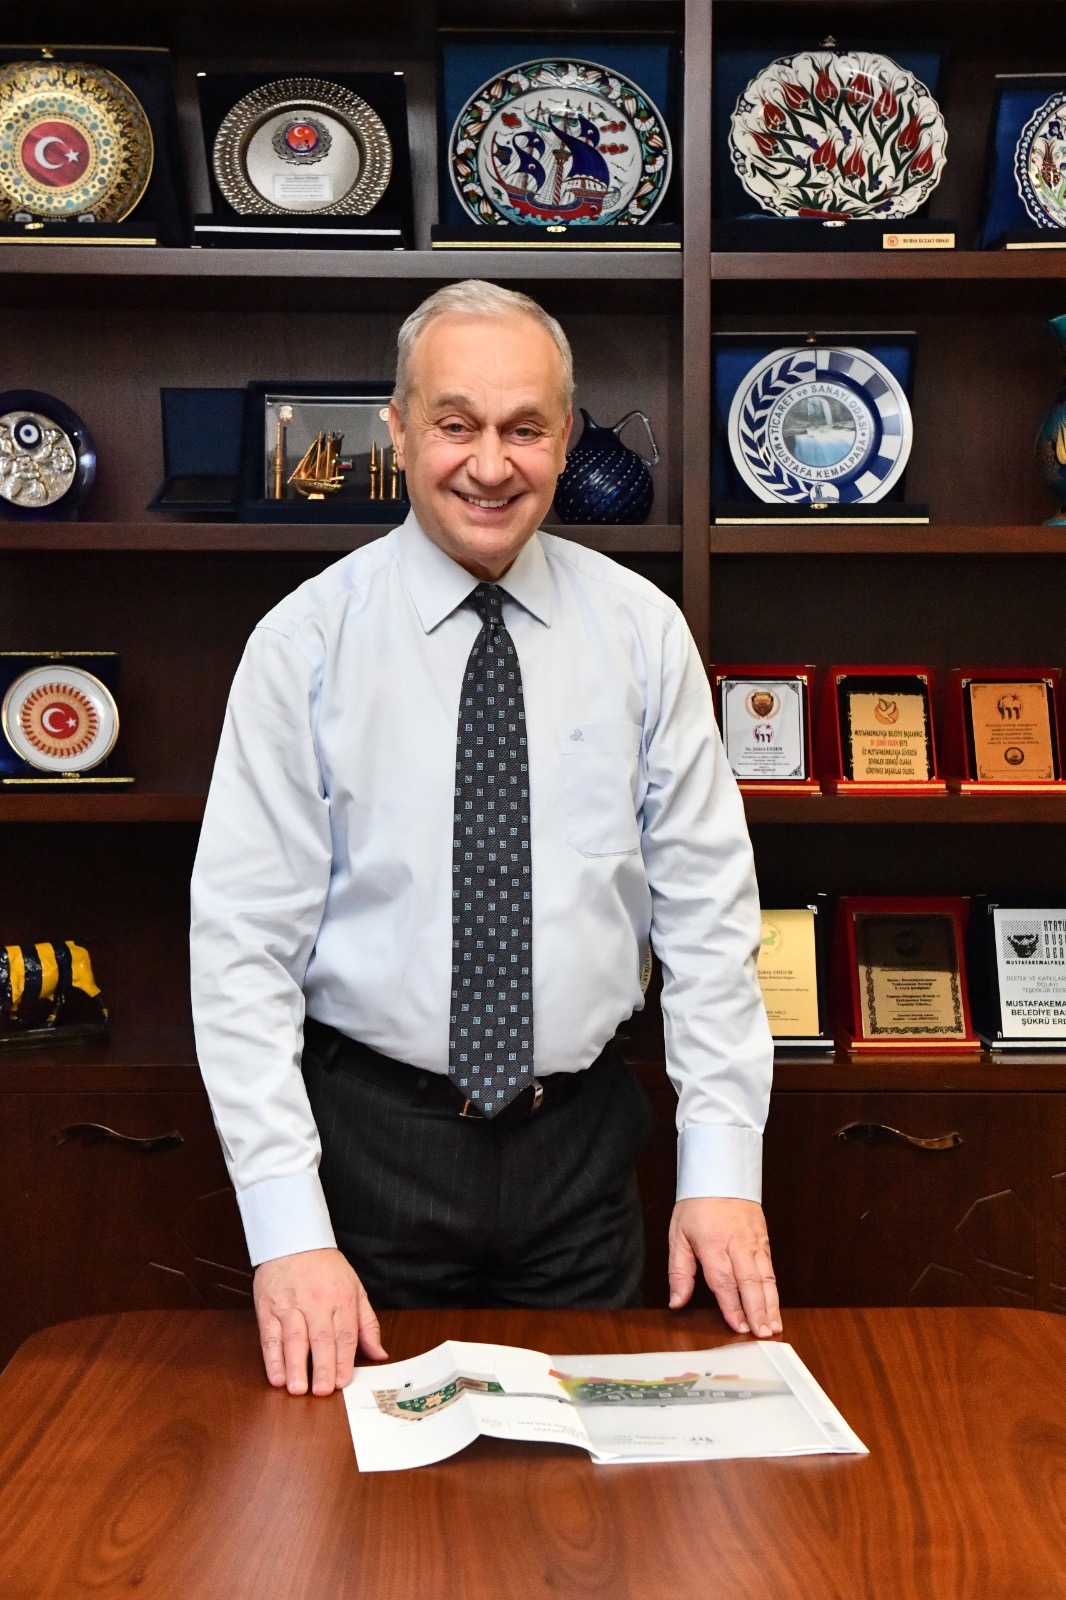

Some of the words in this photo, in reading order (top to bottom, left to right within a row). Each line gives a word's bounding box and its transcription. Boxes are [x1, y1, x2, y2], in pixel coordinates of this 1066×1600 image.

[769, 393, 795, 434] TİCARET
[796, 388, 808, 397] ve
[811, 384, 849, 401] SANAYİ
[849, 400, 868, 431] ODASI
[774, 443, 812, 480] MUSTAFA
[816, 440, 867, 478] KEMALPAŞA
[1021, 1017, 1050, 1026] ŞÜKRÜ
